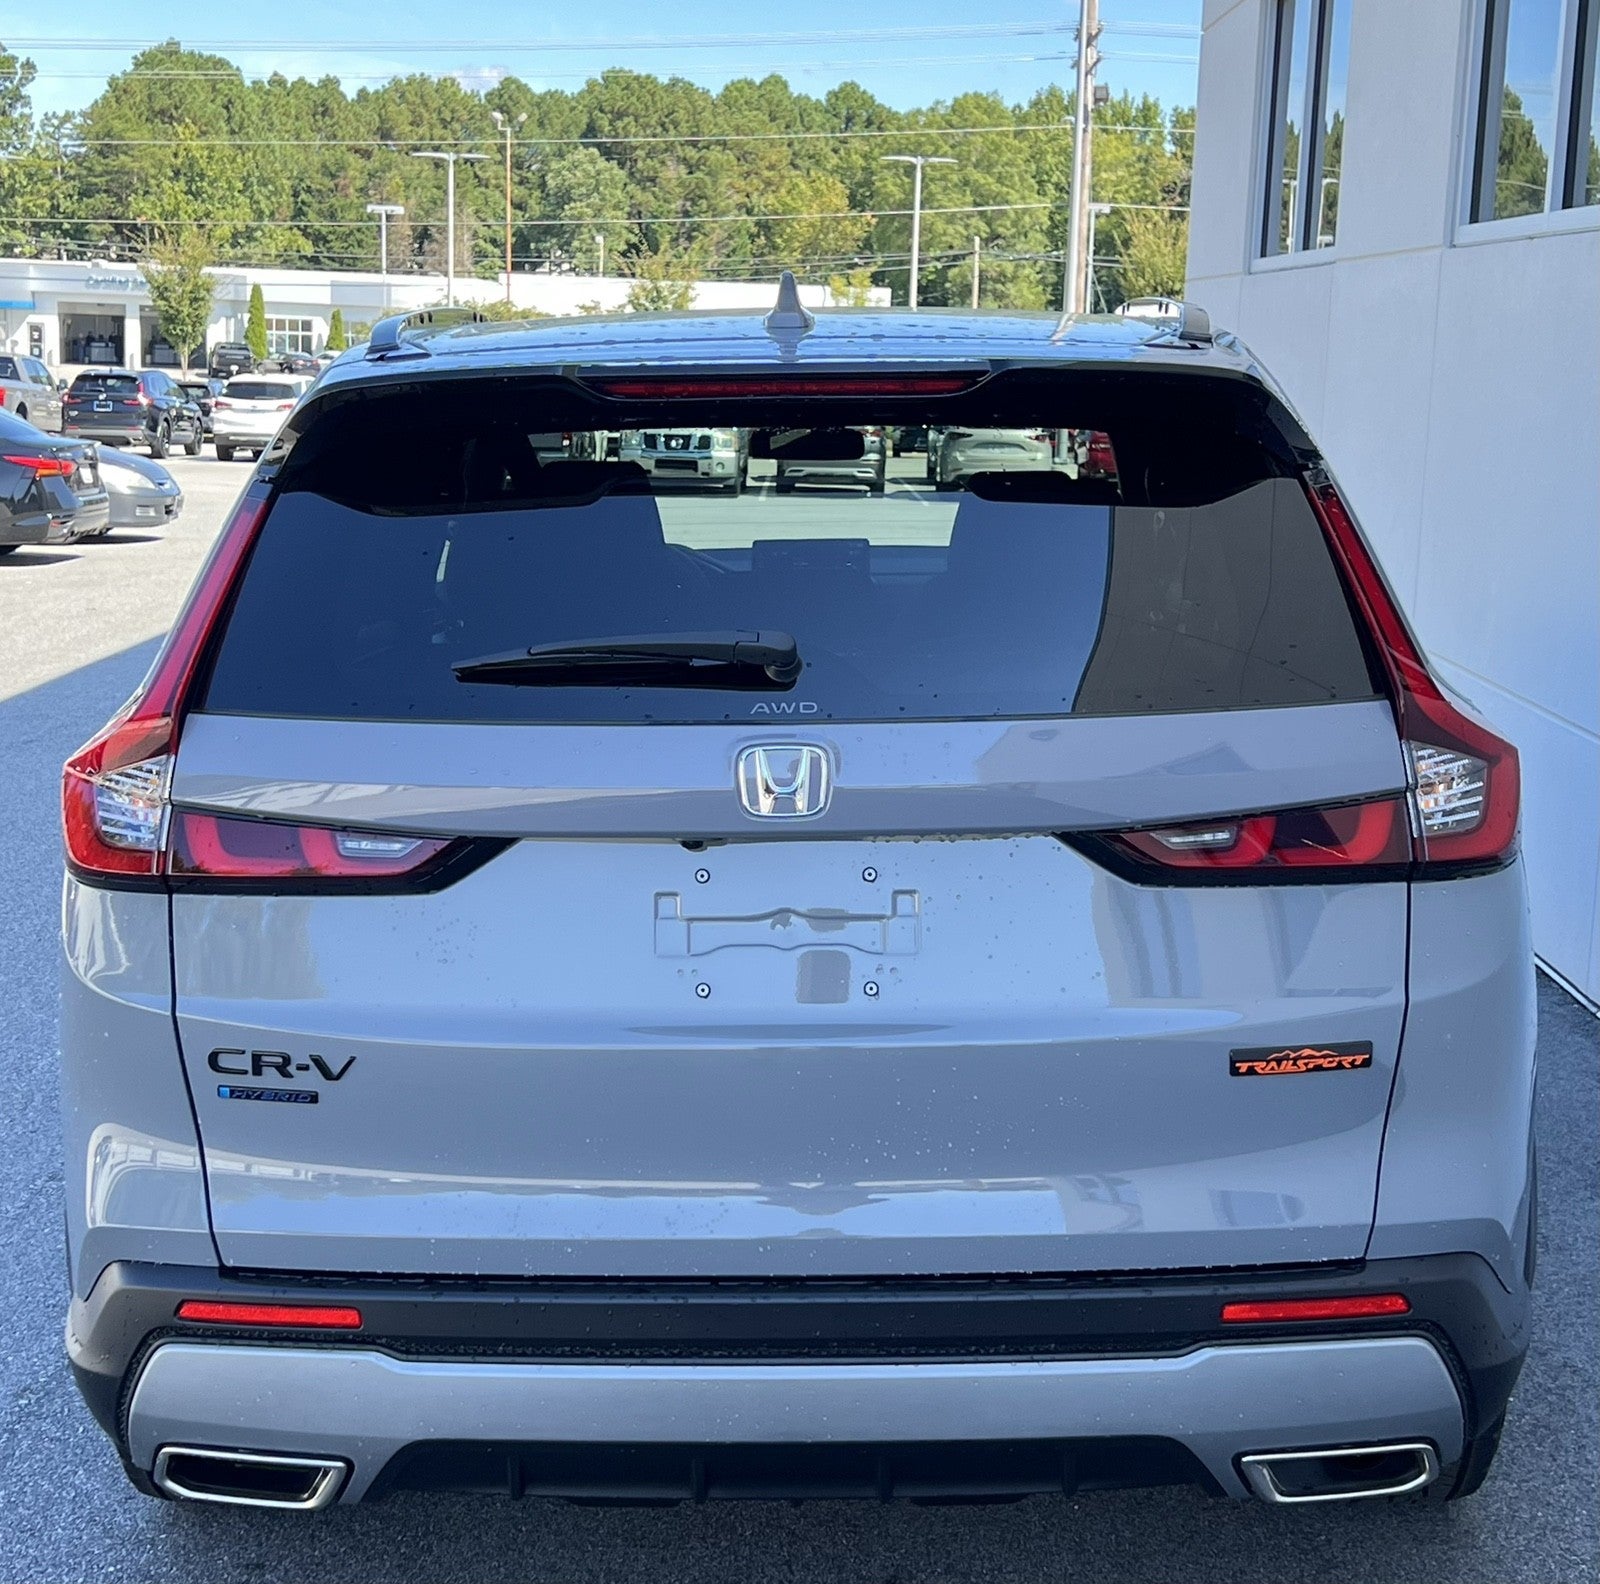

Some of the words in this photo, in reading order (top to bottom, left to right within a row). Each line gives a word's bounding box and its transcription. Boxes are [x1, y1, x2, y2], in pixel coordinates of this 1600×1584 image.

[750, 702, 818, 714] AWD
[207, 1047, 357, 1081] CR-V
[1235, 1054, 1370, 1075] TRAILSPORT
[231, 1088, 313, 1103] HYBRID
